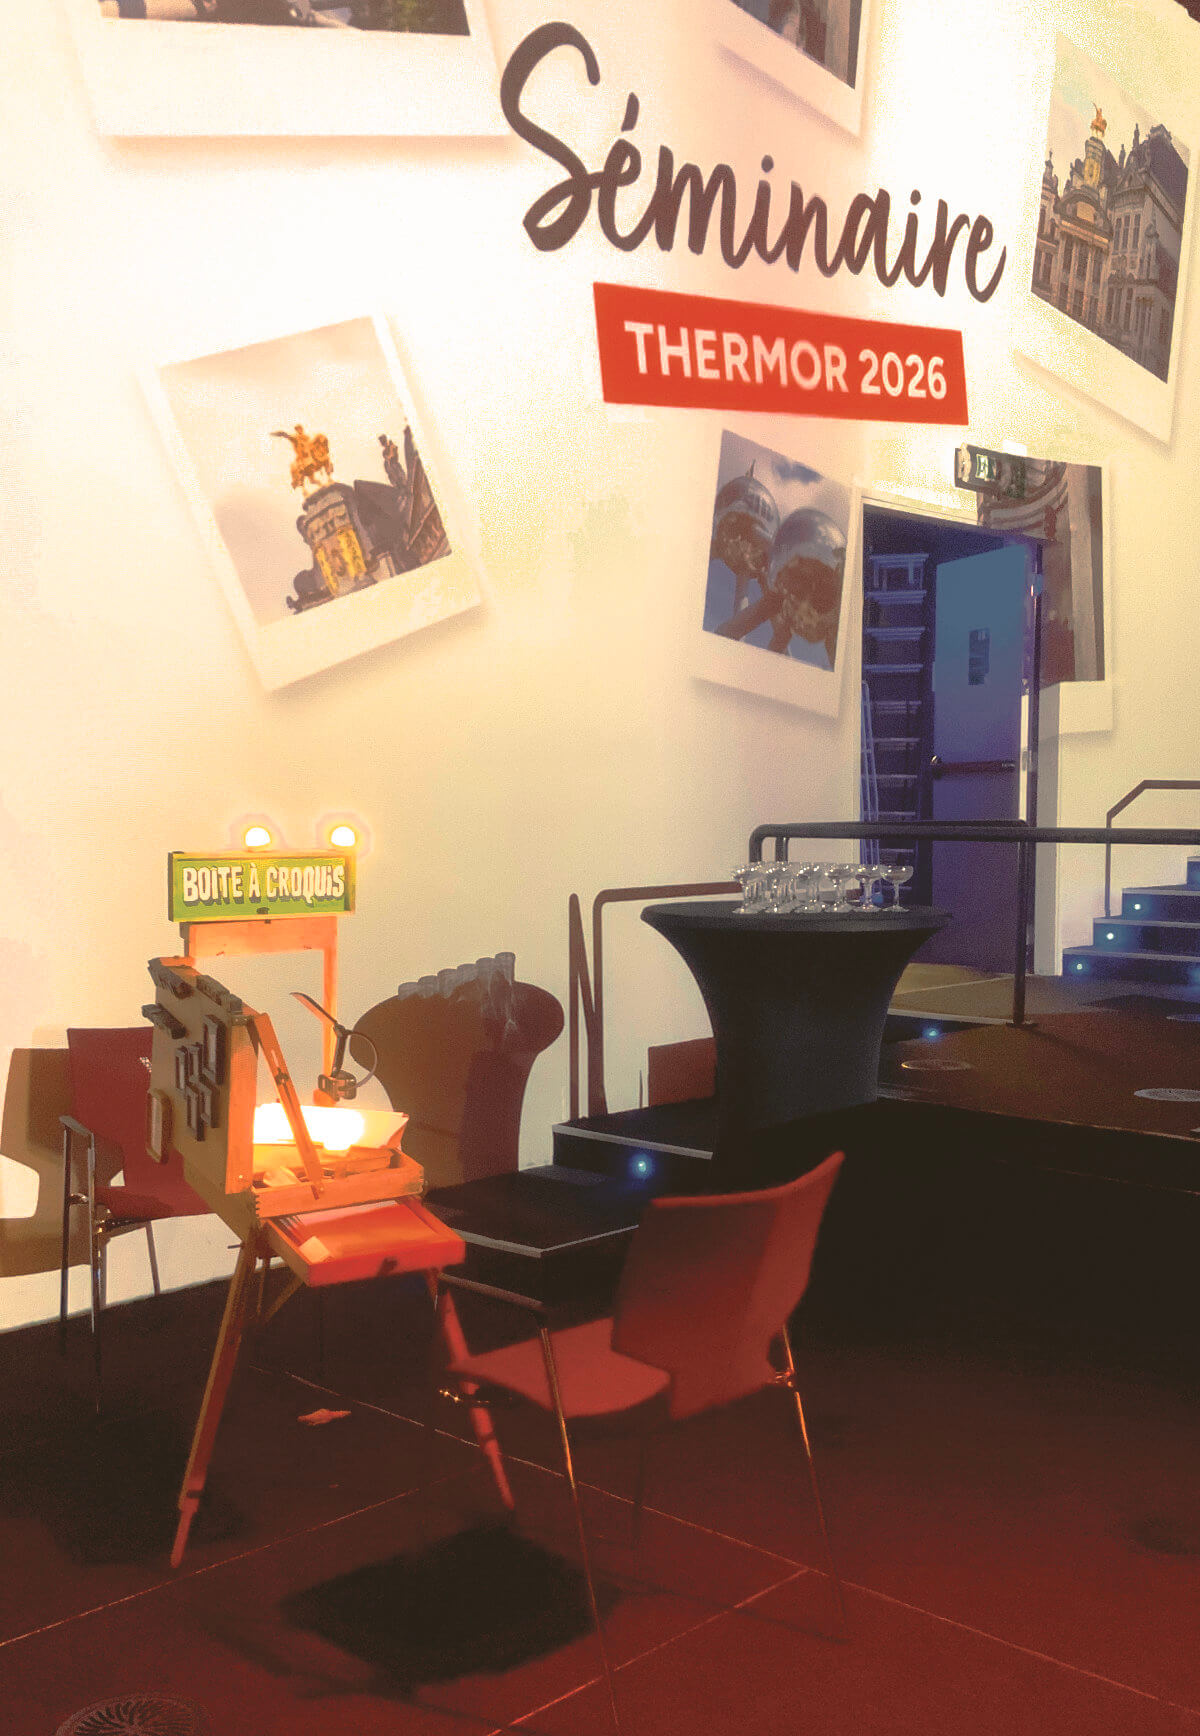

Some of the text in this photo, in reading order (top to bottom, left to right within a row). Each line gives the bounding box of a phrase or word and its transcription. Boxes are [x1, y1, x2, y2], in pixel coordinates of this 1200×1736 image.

[501, 21, 1006, 303] Séminaire
[623, 320, 948, 400] THERMOR 2026
[248, 862, 261, 900] À
